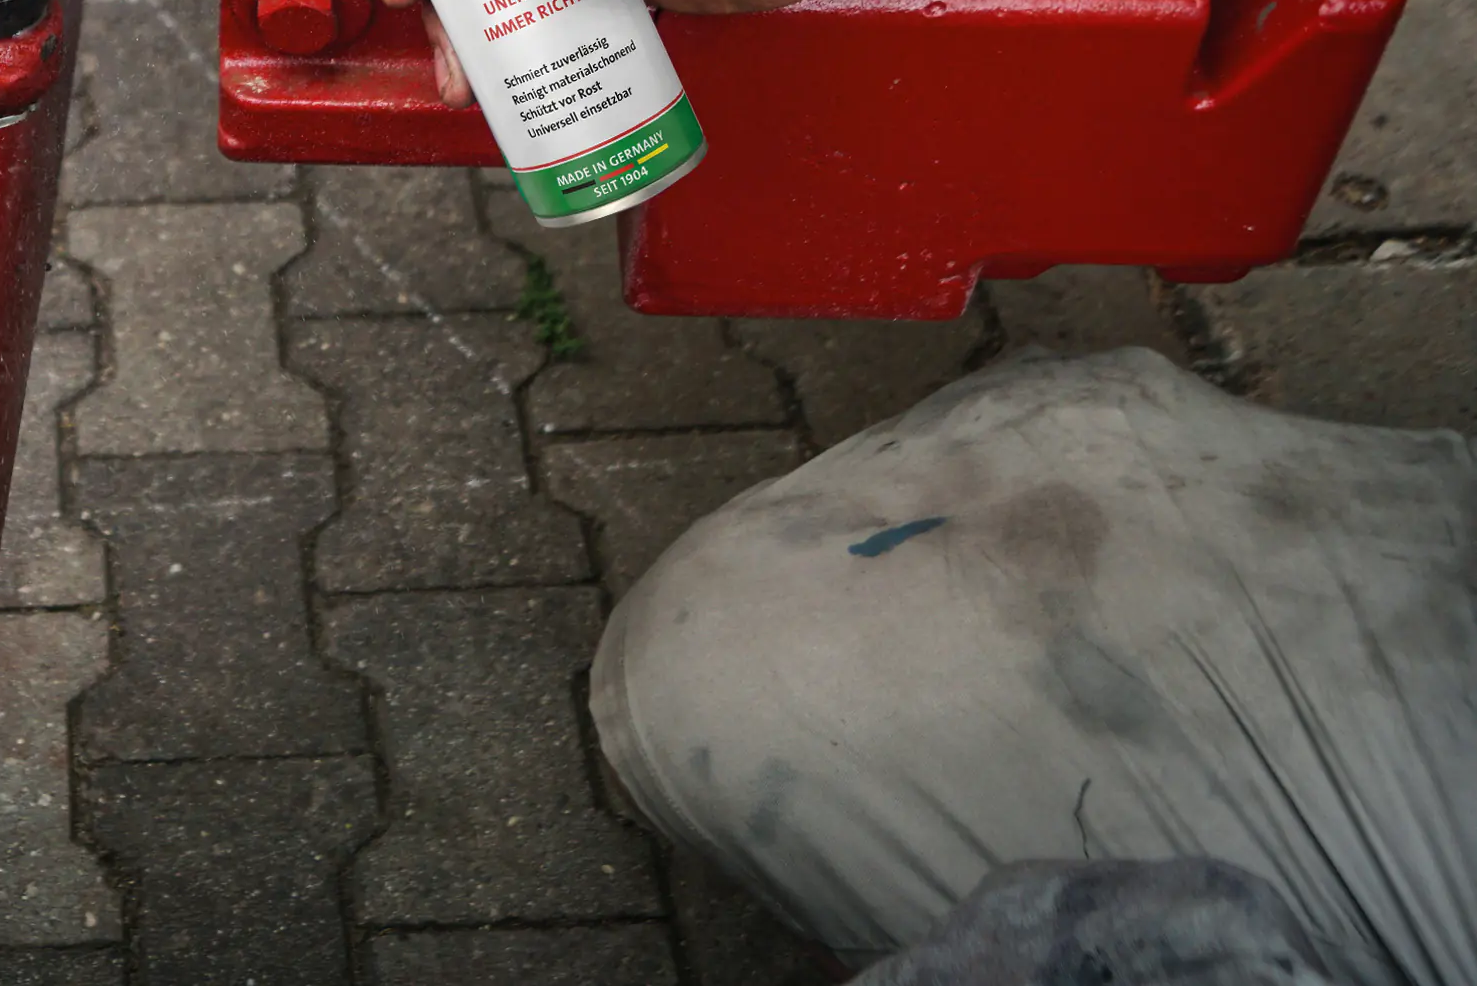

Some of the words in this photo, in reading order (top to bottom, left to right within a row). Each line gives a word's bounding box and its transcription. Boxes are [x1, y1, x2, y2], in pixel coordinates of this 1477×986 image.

[483, 11, 536, 42] IMMER
[504, 64, 550, 89] Schmiert
[550, 37, 609, 71] zuverlässig
[512, 85, 548, 106] Reinigt
[548, 39, 637, 93] materialschonend
[520, 101, 558, 122] Schützt
[558, 93, 577, 108] vor
[578, 80, 603, 100] Rost
[527, 111, 579, 139] Universell
[580, 86, 633, 119] einsetzbar
[556, 166, 592, 187] MADE
[592, 160, 608, 174] IN
[609, 129, 664, 167] GERMANY
[593, 179, 618, 198] SEIT
[619, 165, 649, 187] 1904
